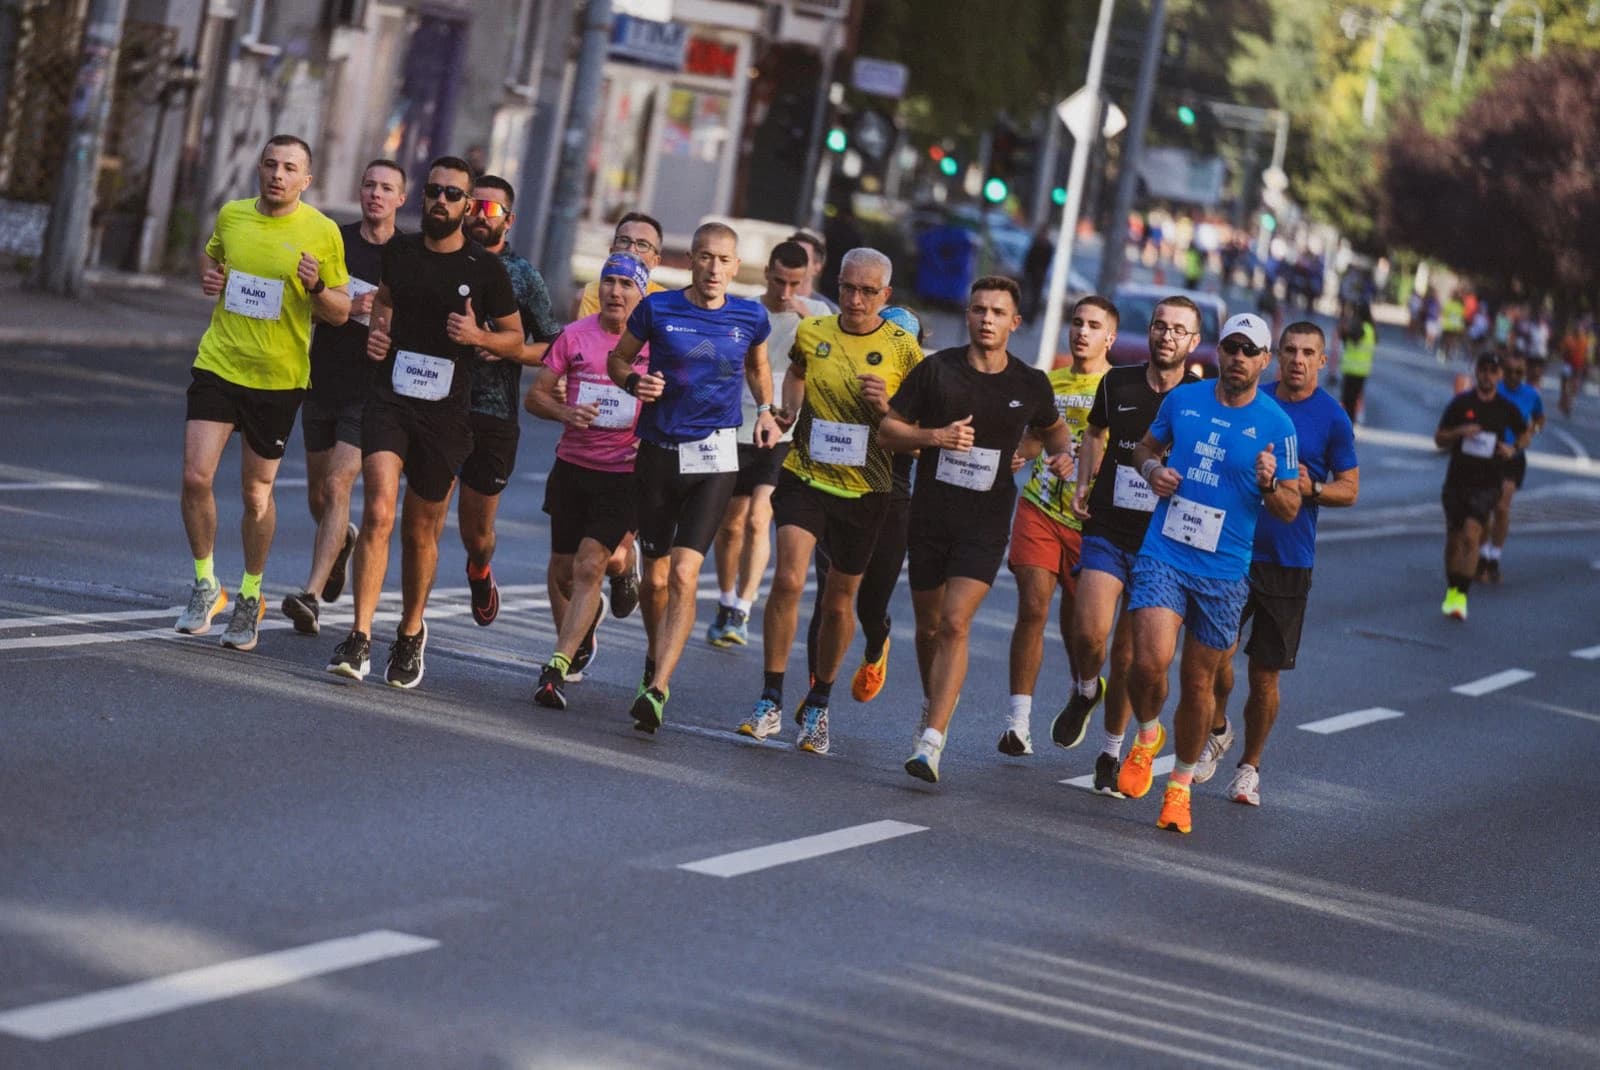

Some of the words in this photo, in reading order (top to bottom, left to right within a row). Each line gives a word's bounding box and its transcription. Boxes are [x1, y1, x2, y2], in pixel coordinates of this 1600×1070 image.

[241, 286, 266, 299] RAJKO
[406, 366, 439, 379] OGNJEN
[825, 434, 852, 445] SENAD
[1118, 439, 1136, 449] Add
[1207, 431, 1221, 446] ALL
[1193, 441, 1227, 462] RUNNERS
[944, 456, 992, 472] PIERRE-MICHEL
[1199, 456, 1215, 472] ARE
[1186, 466, 1220, 488] BEAUTIFUL
[1182, 512, 1202, 526] EMIR
